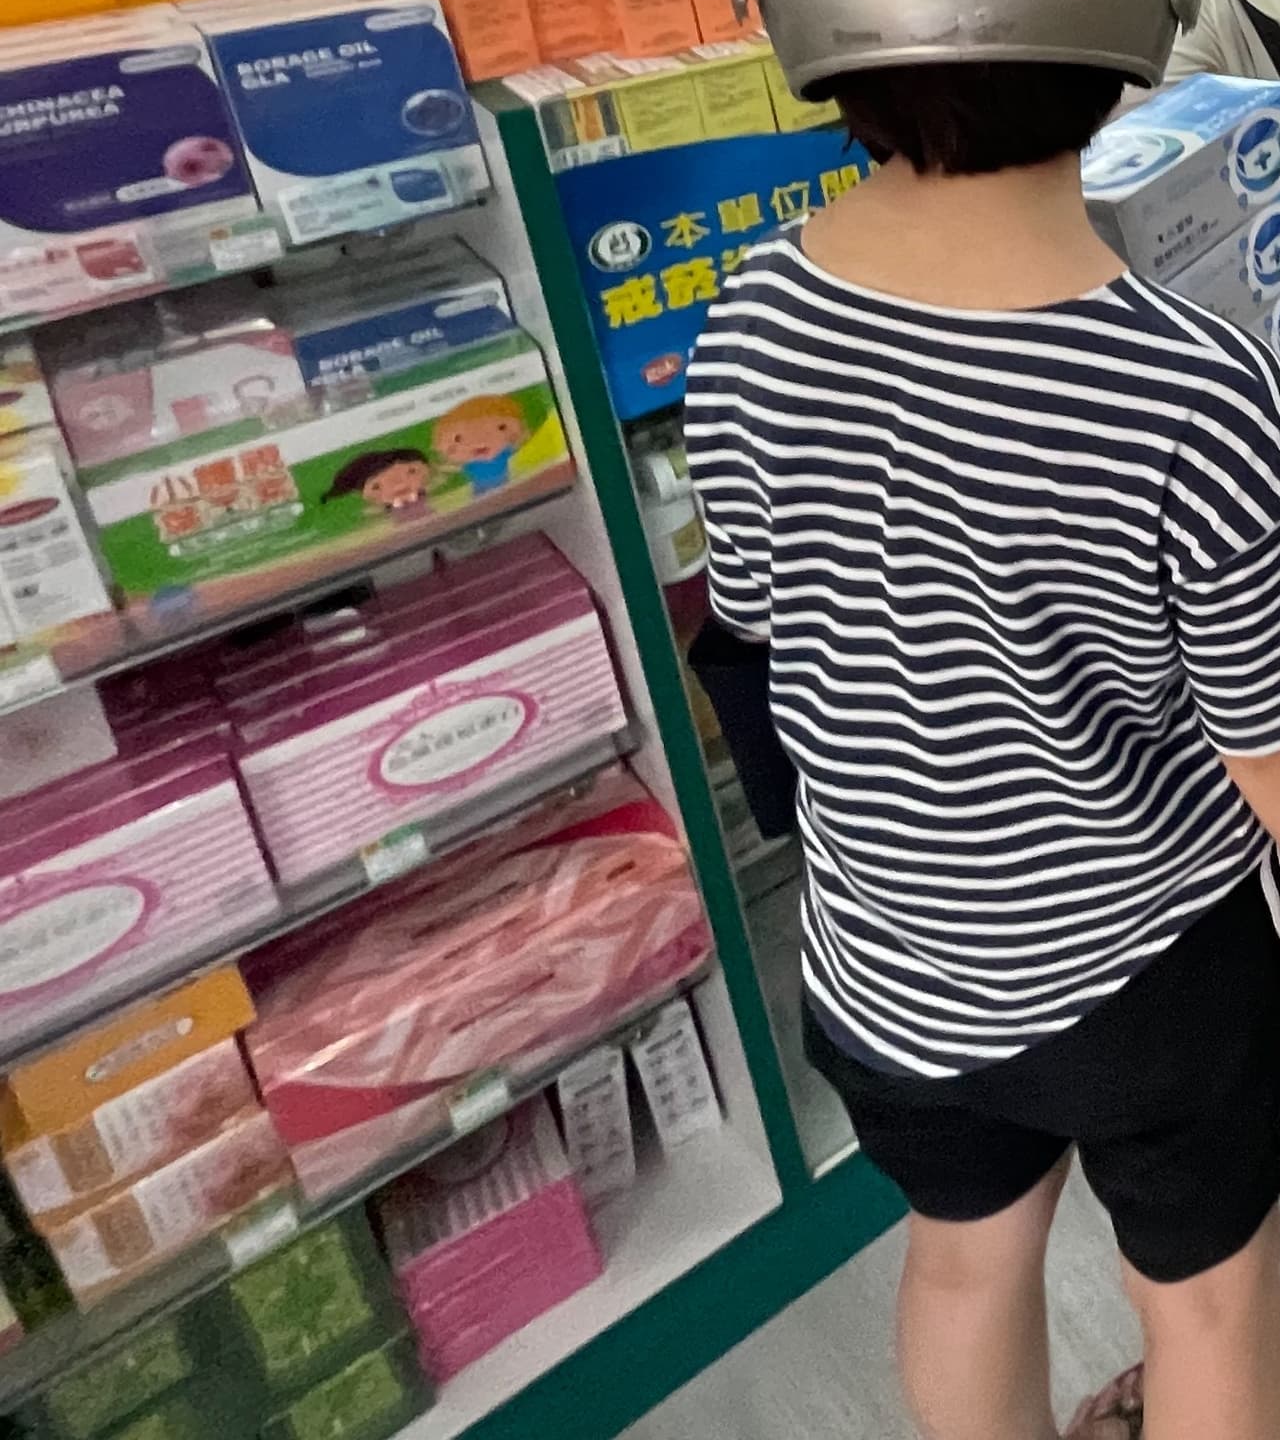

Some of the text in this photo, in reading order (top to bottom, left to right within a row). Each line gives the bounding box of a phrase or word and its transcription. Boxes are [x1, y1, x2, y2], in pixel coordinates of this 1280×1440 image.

[0, 84, 126, 120] HINACEA
[660, 159, 881, 249] 本單位開
